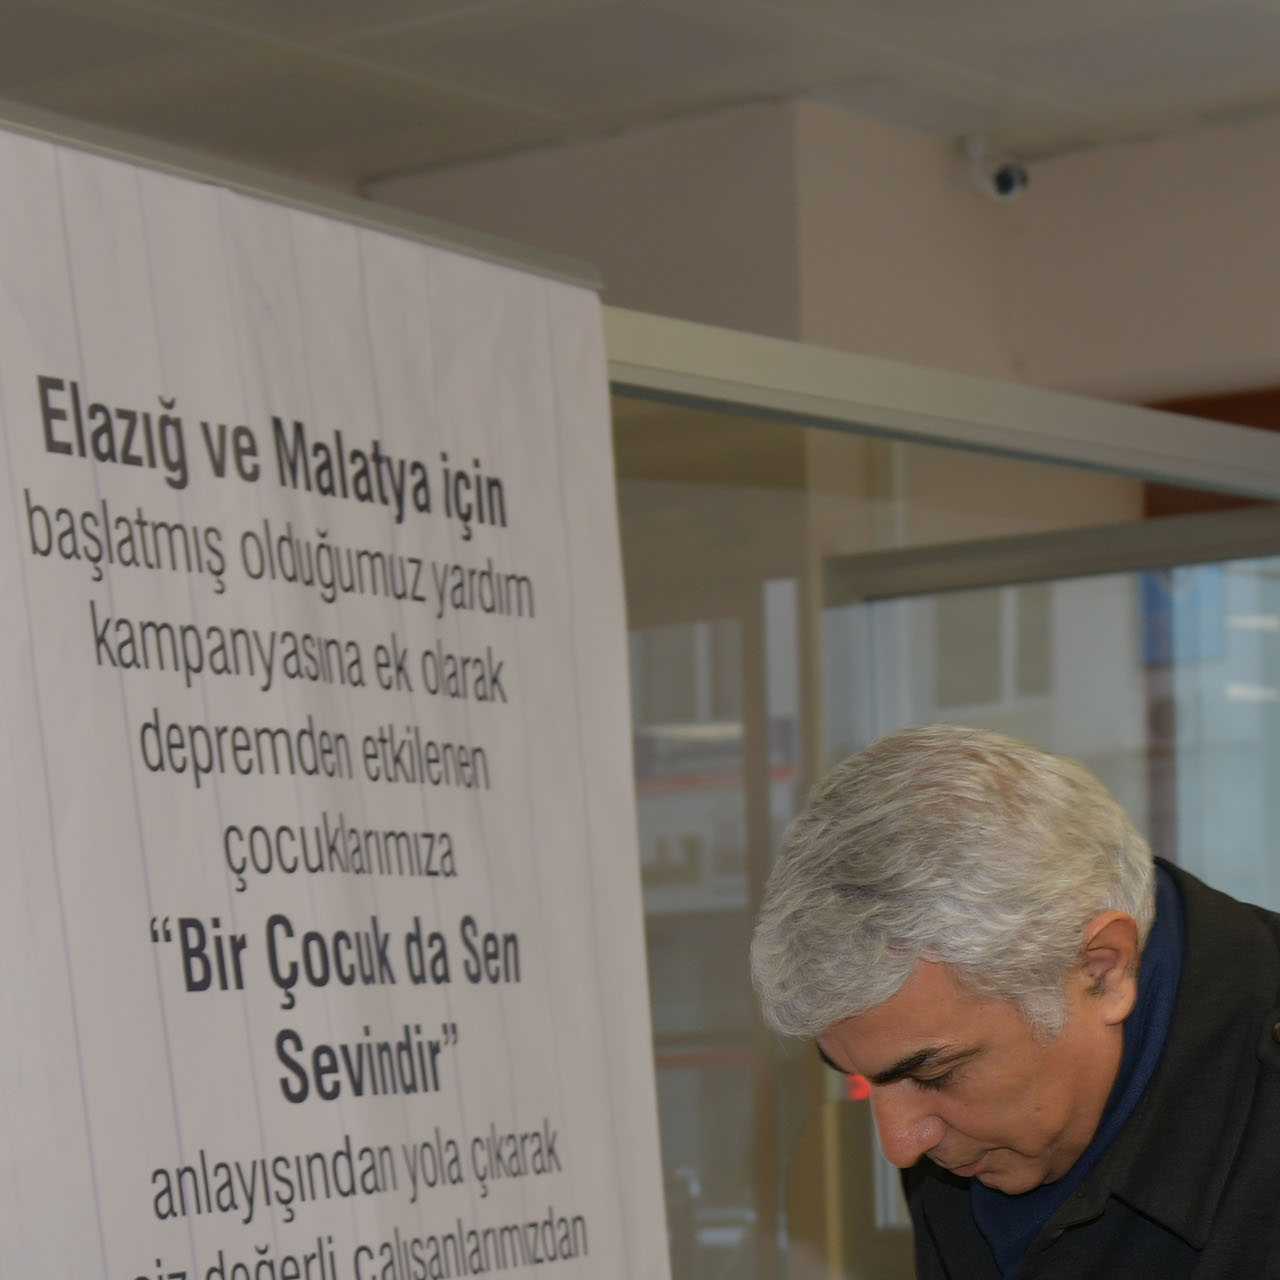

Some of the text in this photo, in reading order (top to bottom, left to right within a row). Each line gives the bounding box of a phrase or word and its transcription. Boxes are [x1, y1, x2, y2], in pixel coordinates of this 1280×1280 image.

[36, 374, 508, 541] Elazığ ve Malatya için
[24, 487, 535, 620] başlatmış olduğumuz yardım
[89, 599, 509, 703] kampanyasına ek olarak
[139, 707, 491, 791] depremden etkilenen
[224, 810, 458, 893] çocuklarımıza
[265, 912, 397, 1010] Çocuk
[405, 915, 451, 987] da
[460, 913, 522, 986] Sen
[150, 1115, 563, 1224] anlayışından yola çıkarak
